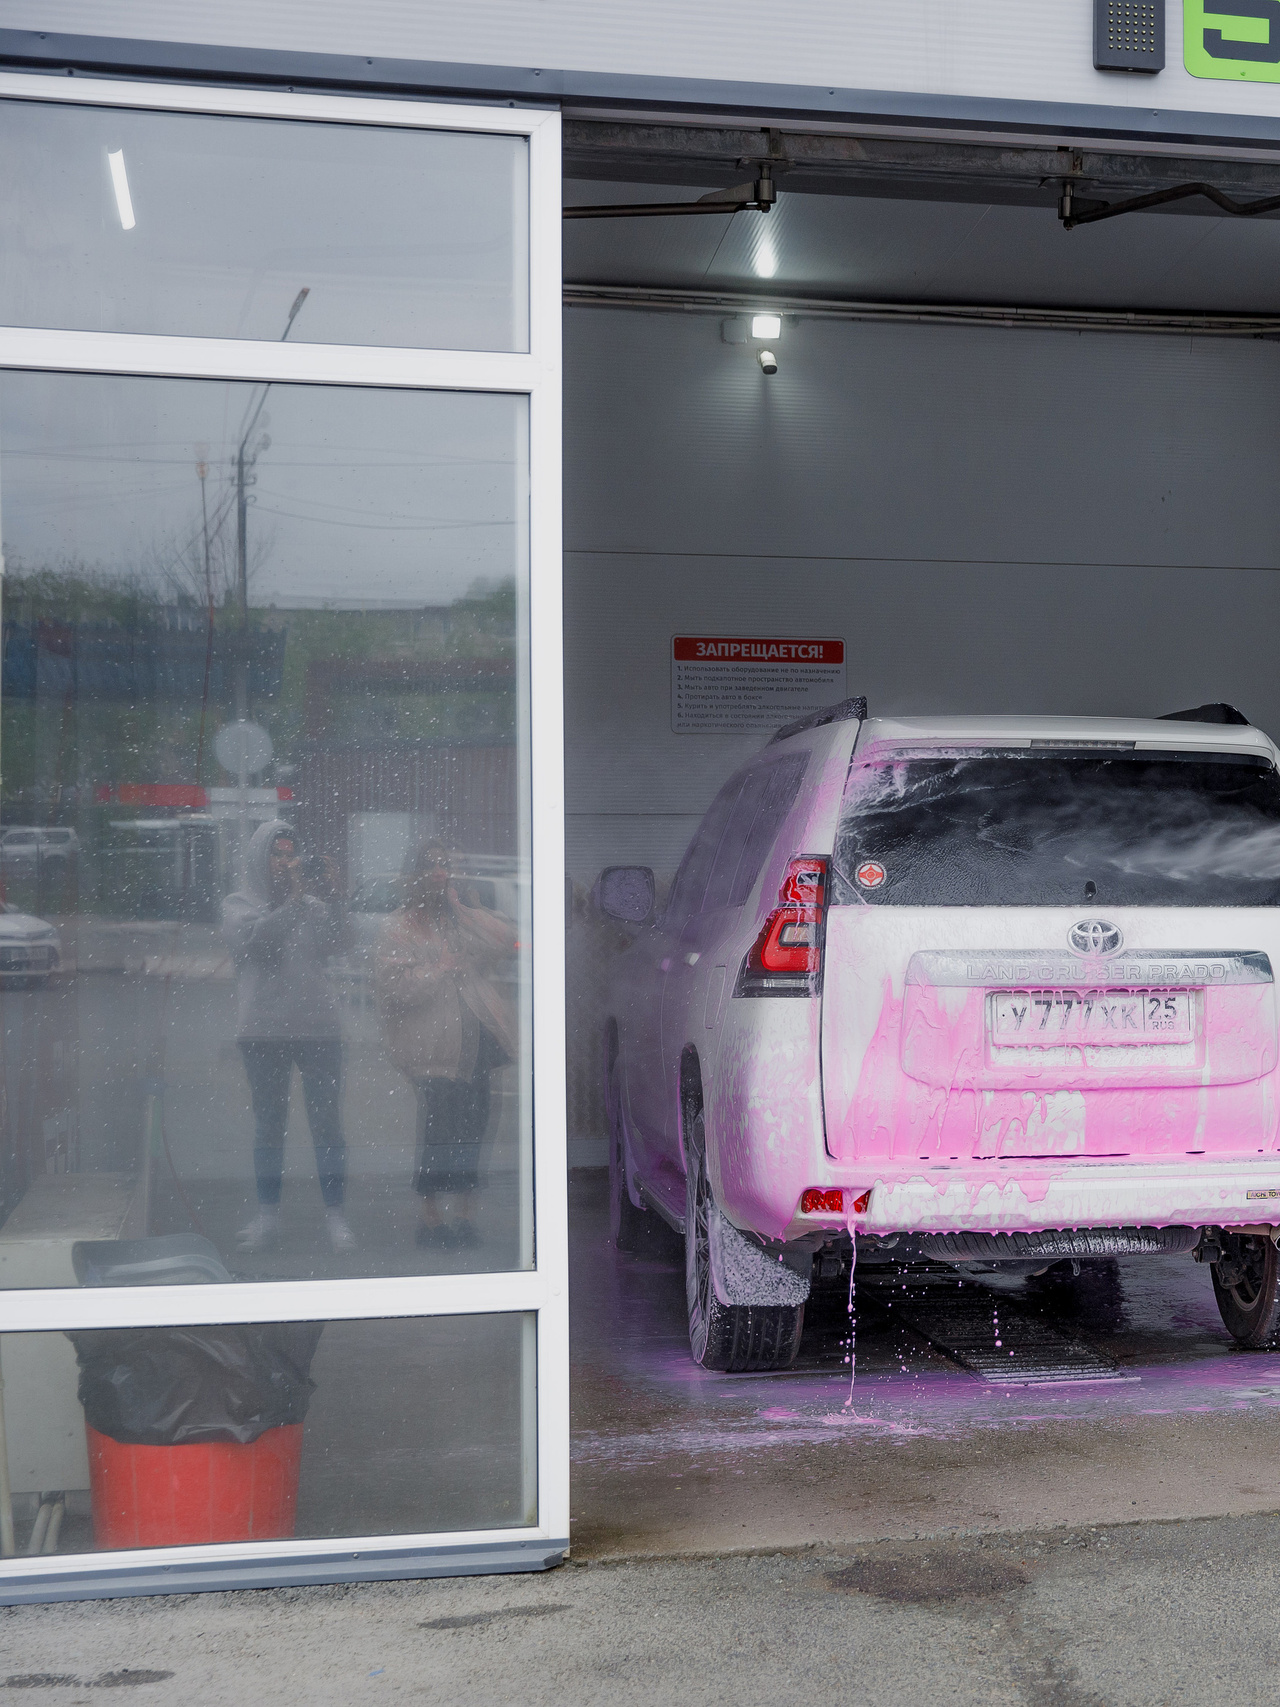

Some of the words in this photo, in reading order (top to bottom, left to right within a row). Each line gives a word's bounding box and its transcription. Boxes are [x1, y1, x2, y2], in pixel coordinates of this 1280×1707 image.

[696, 642, 823, 660] ЗАПРЕЩАЕТСЯ!
[966, 964, 1031, 980] LAND
[1037, 964, 1141, 980] CRUSER
[1149, 963, 1226, 980] PRADO
[1148, 997, 1177, 1020] 25
[1152, 1021, 1175, 1031] RUS
